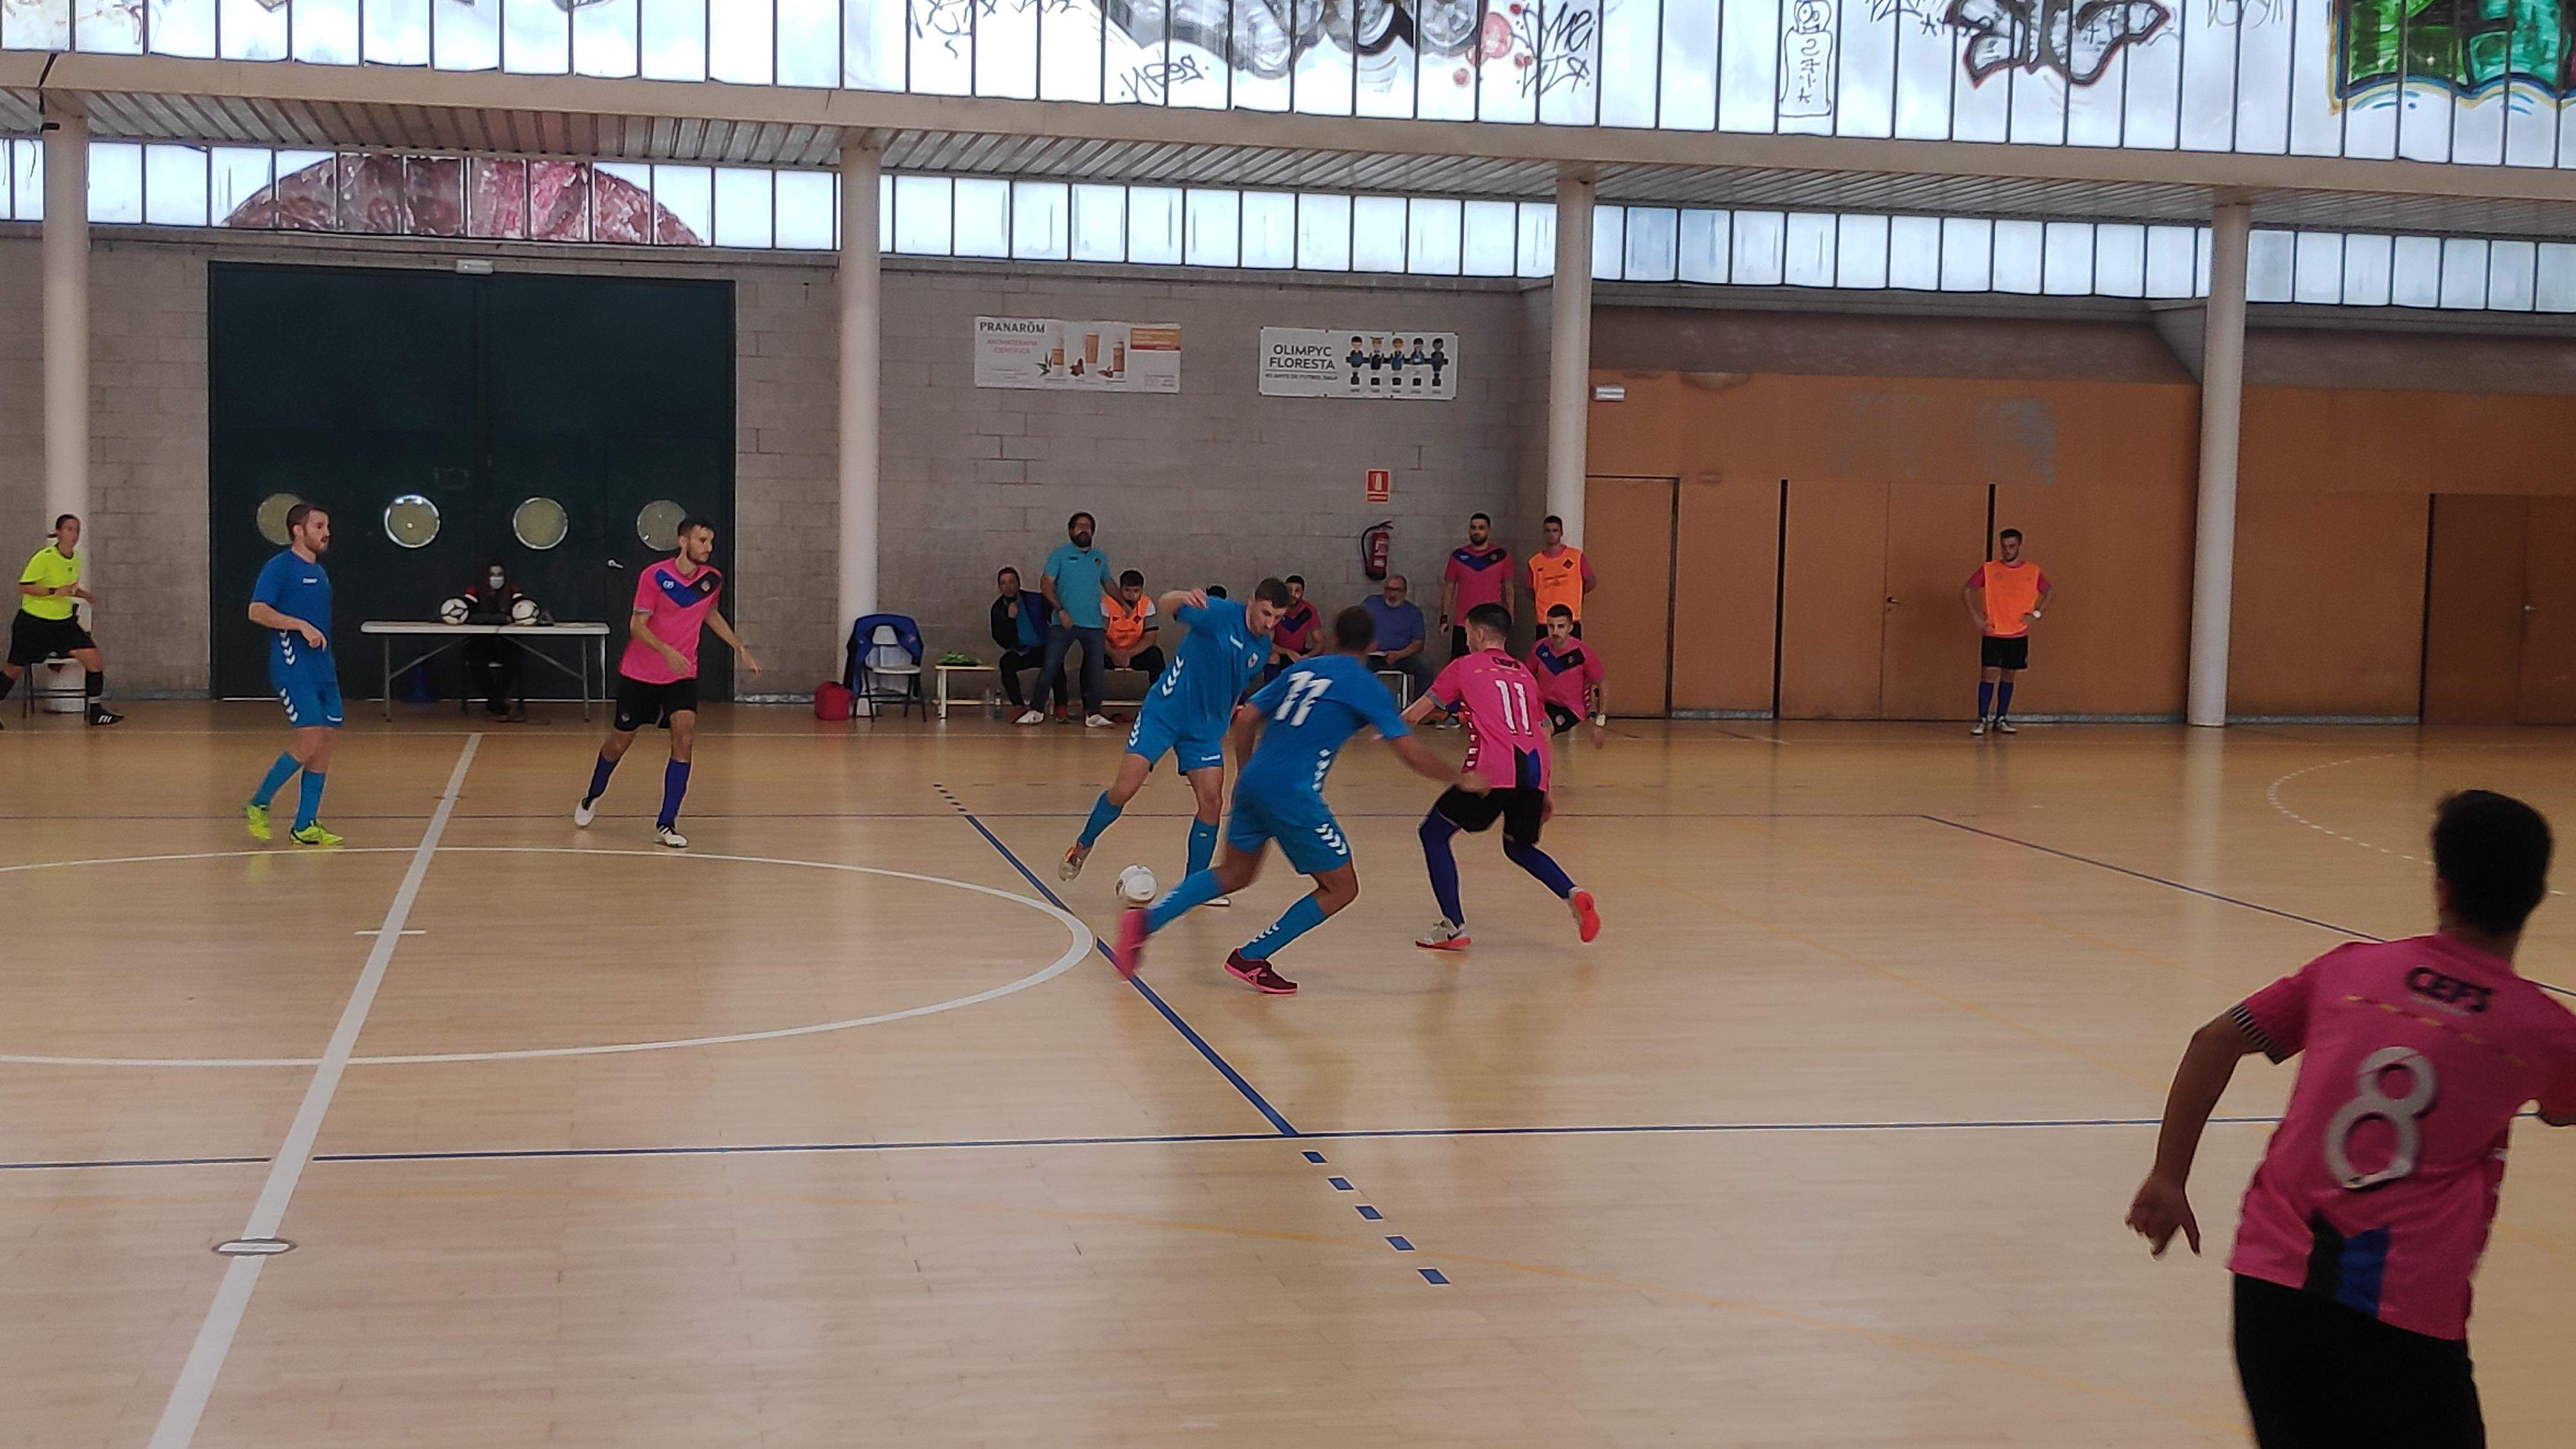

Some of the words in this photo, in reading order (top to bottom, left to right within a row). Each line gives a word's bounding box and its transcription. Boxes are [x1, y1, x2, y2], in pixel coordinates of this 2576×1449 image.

[1269, 356, 1335, 370] FLORESTA
[1273, 344, 1332, 356] OLIMPYC
[1274, 670, 1333, 727] 11
[1494, 679, 1533, 737] 11
[2324, 1046, 2439, 1190] 8
